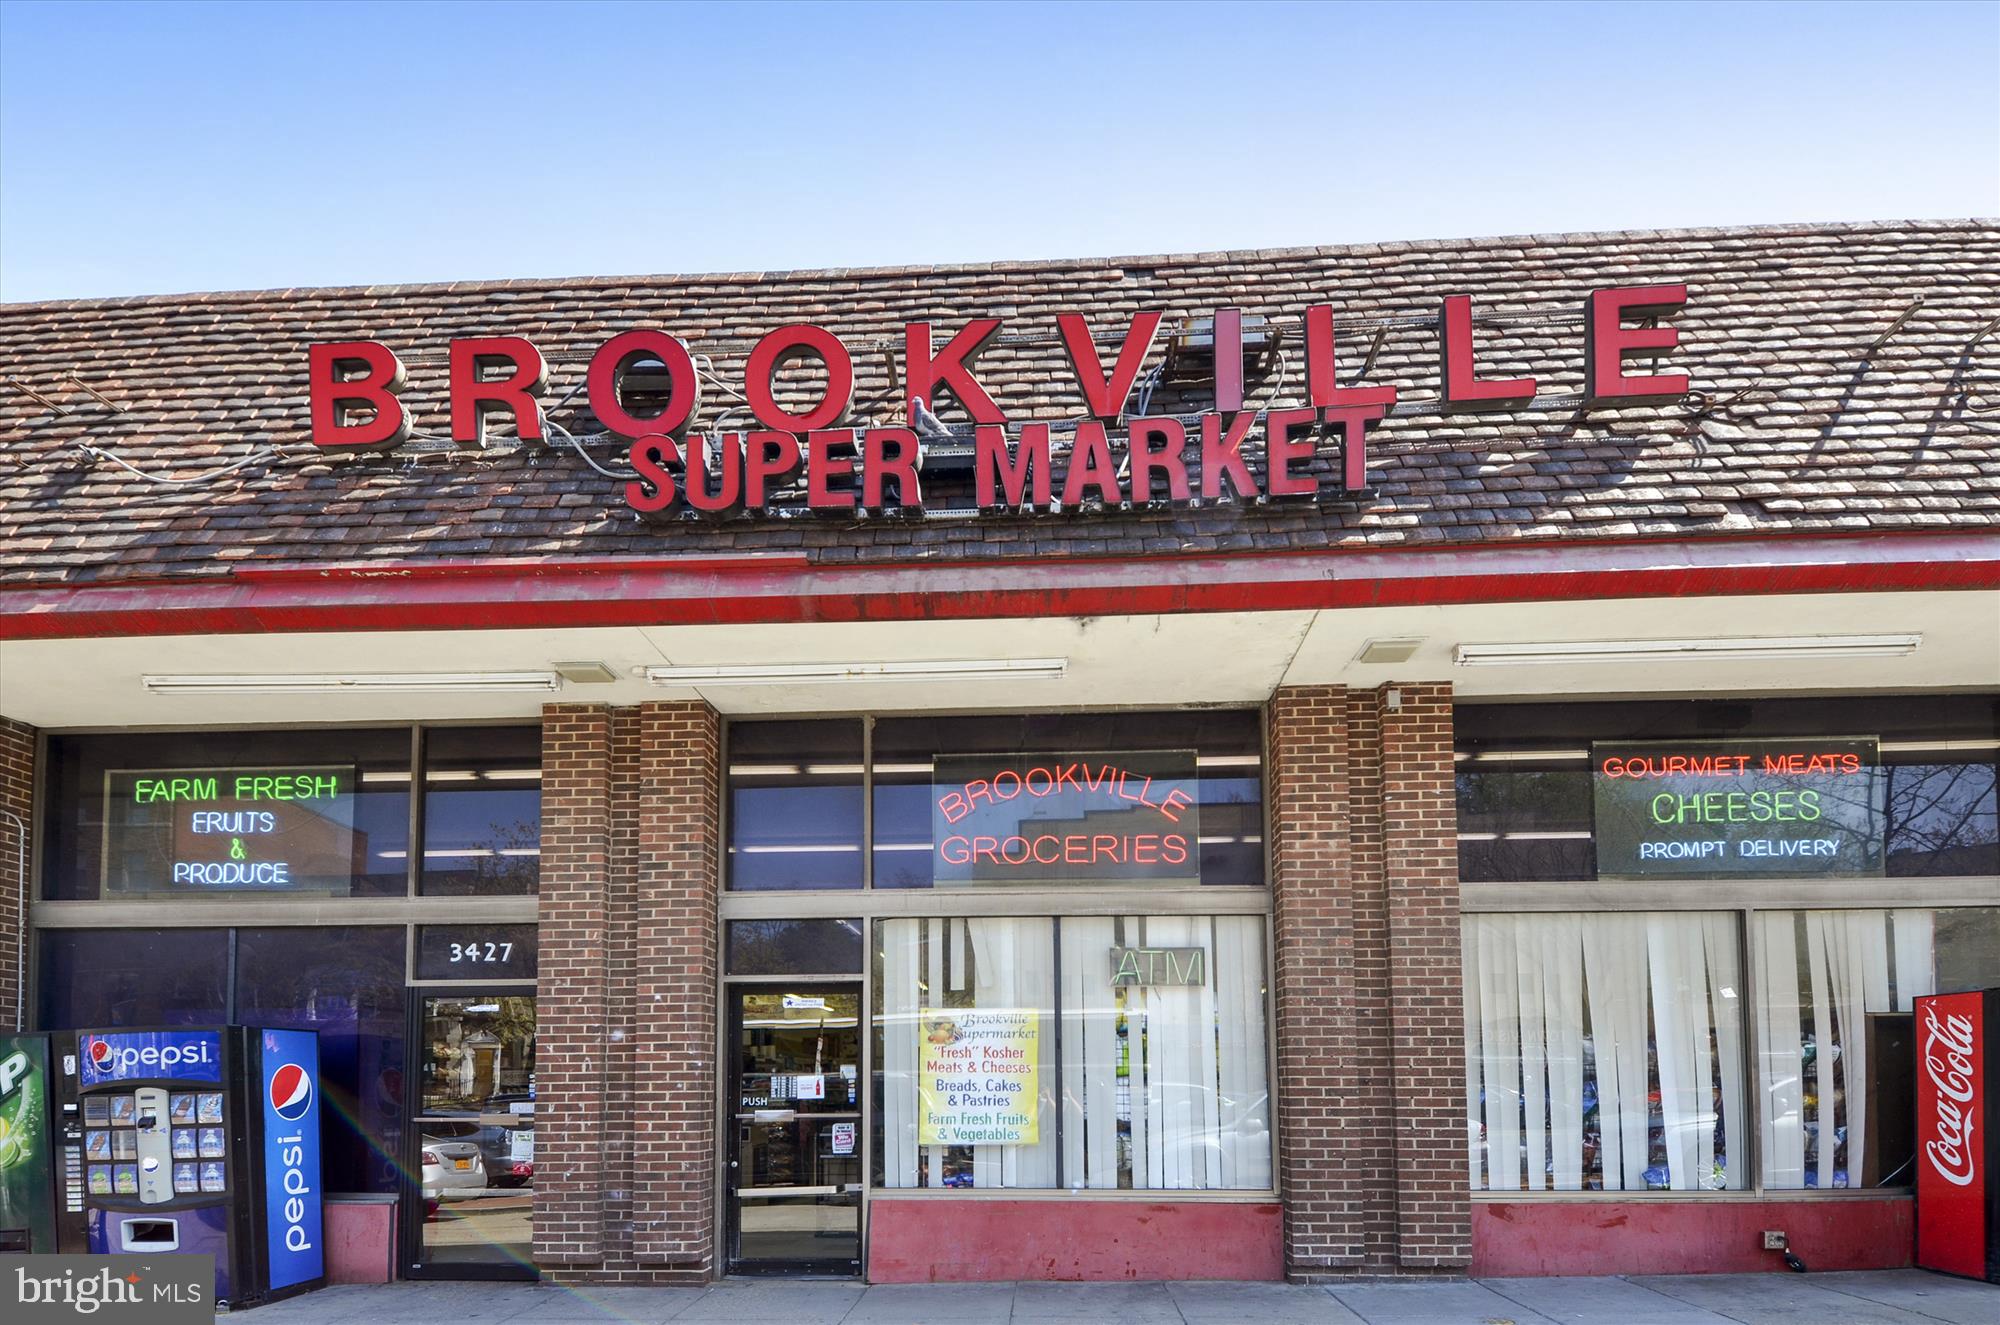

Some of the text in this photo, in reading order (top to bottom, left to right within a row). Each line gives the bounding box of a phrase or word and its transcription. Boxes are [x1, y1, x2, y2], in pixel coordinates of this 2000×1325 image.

[308, 283, 1690, 450] BROOKVILLE
[624, 403, 1388, 514] SUPER MARKET
[1602, 753, 1860, 778] GOURMET MEATS
[135, 775, 337, 802] FARM FRESH
[938, 763, 1192, 823] BROOKVILLE
[1652, 791, 1821, 824] CHEESES
[192, 811, 275, 833] FRUITS
[230, 838, 245, 859] &
[940, 834, 1187, 864] GROCERIES
[1640, 839, 1840, 860] PROMPT DELIVERY
[173, 862, 288, 884] PRODUCE
[449, 943, 513, 962] 3427
[1110, 950, 1201, 985] ATM
[961, 1014, 1029, 1028] Brookville
[120, 1041, 208, 1070] pepsi
[983, 1046, 1025, 1059] Kosher
[927, 1061, 1032, 1073] Meats & Cheeses
[936, 1079, 1022, 1092] Breads, Cakes
[1925, 1003, 1975, 1186] Coca-Cola
[742, 1096, 768, 1106] PUSH
[948, 1094, 1010, 1106] & Pastries
[928, 1112, 1030, 1125] Farm Fresh Fruits
[937, 1127, 1020, 1142] & Vegetables
[277, 1135, 312, 1252] pepsi
